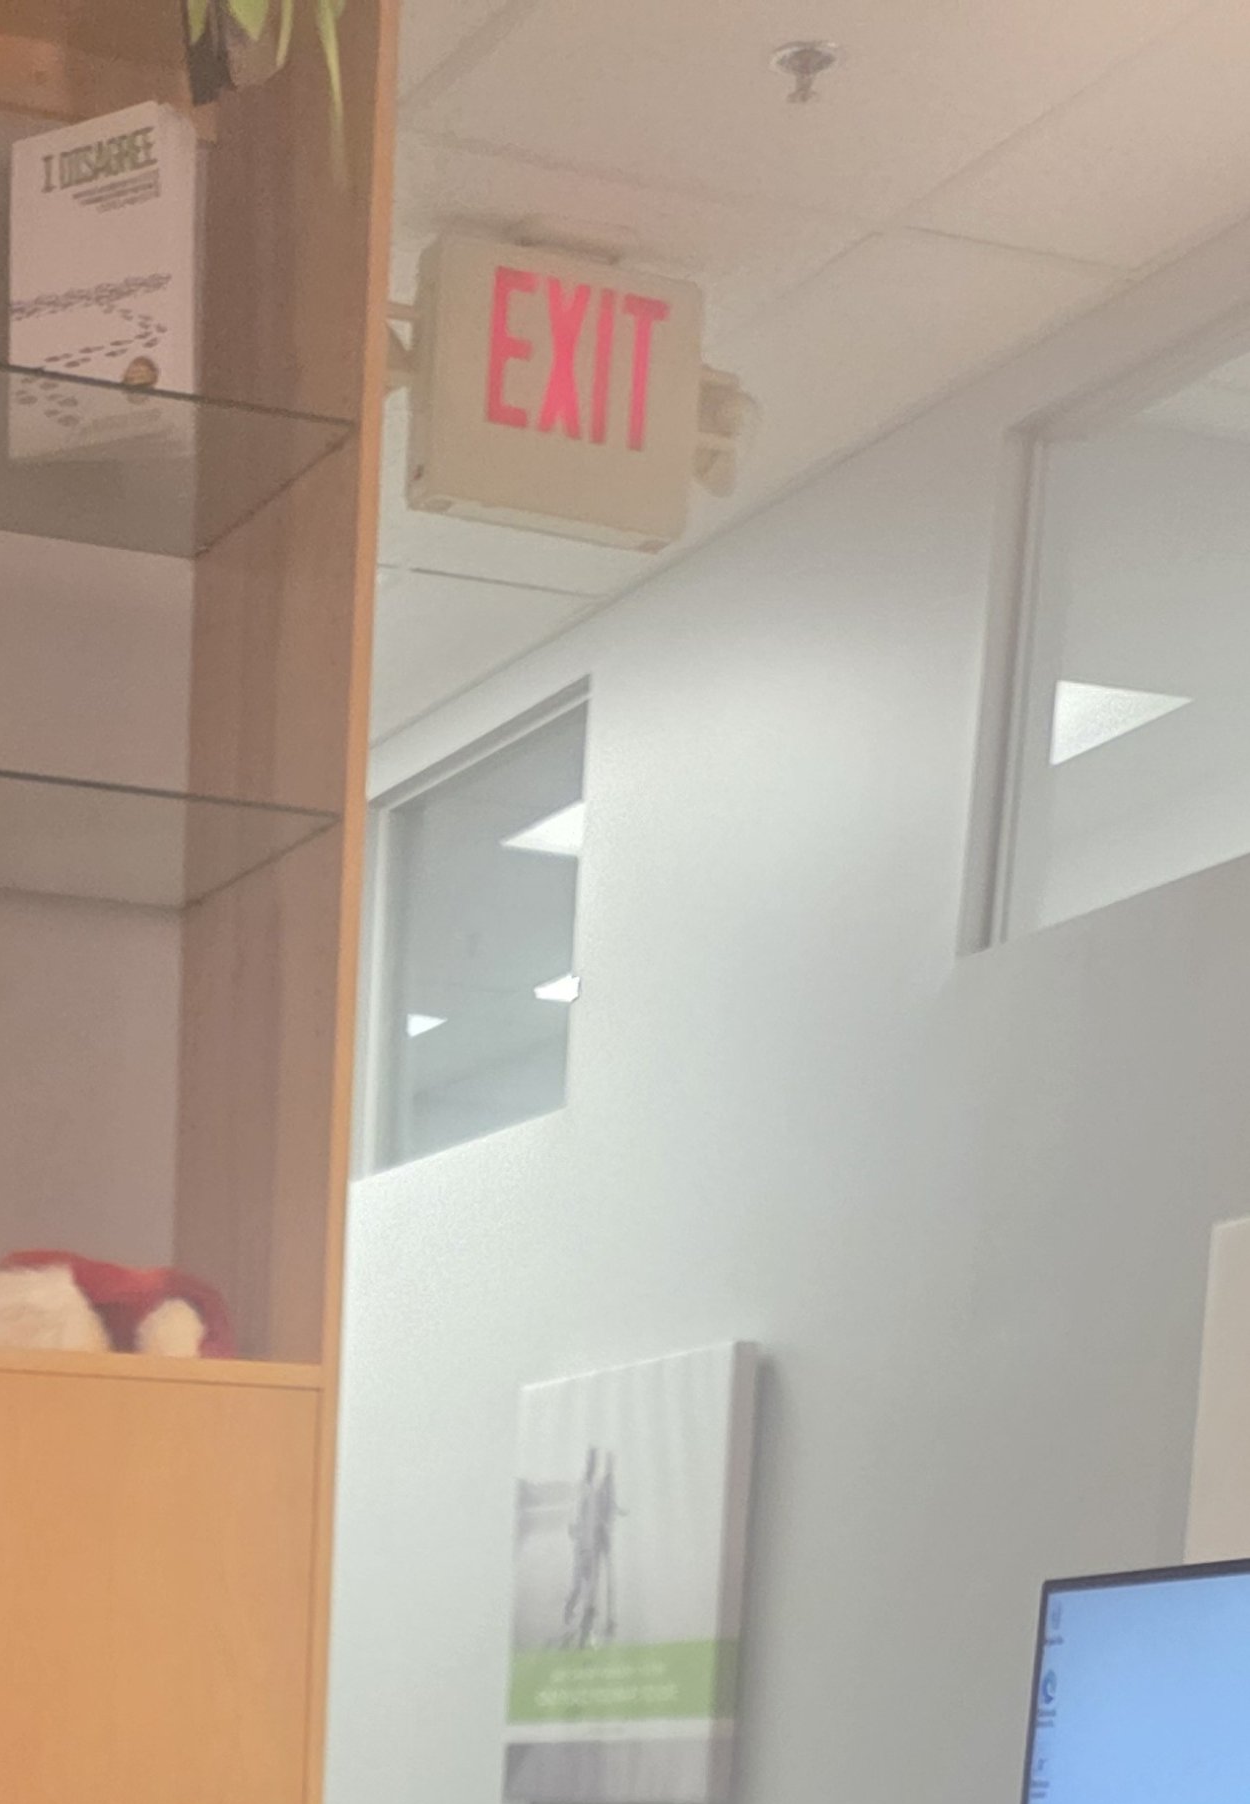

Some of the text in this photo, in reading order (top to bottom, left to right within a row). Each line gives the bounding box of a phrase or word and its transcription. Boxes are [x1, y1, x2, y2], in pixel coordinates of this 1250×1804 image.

[41, 154, 56, 193] I
[59, 127, 158, 190] DISAGREE
[485, 265, 671, 452] EXIT
